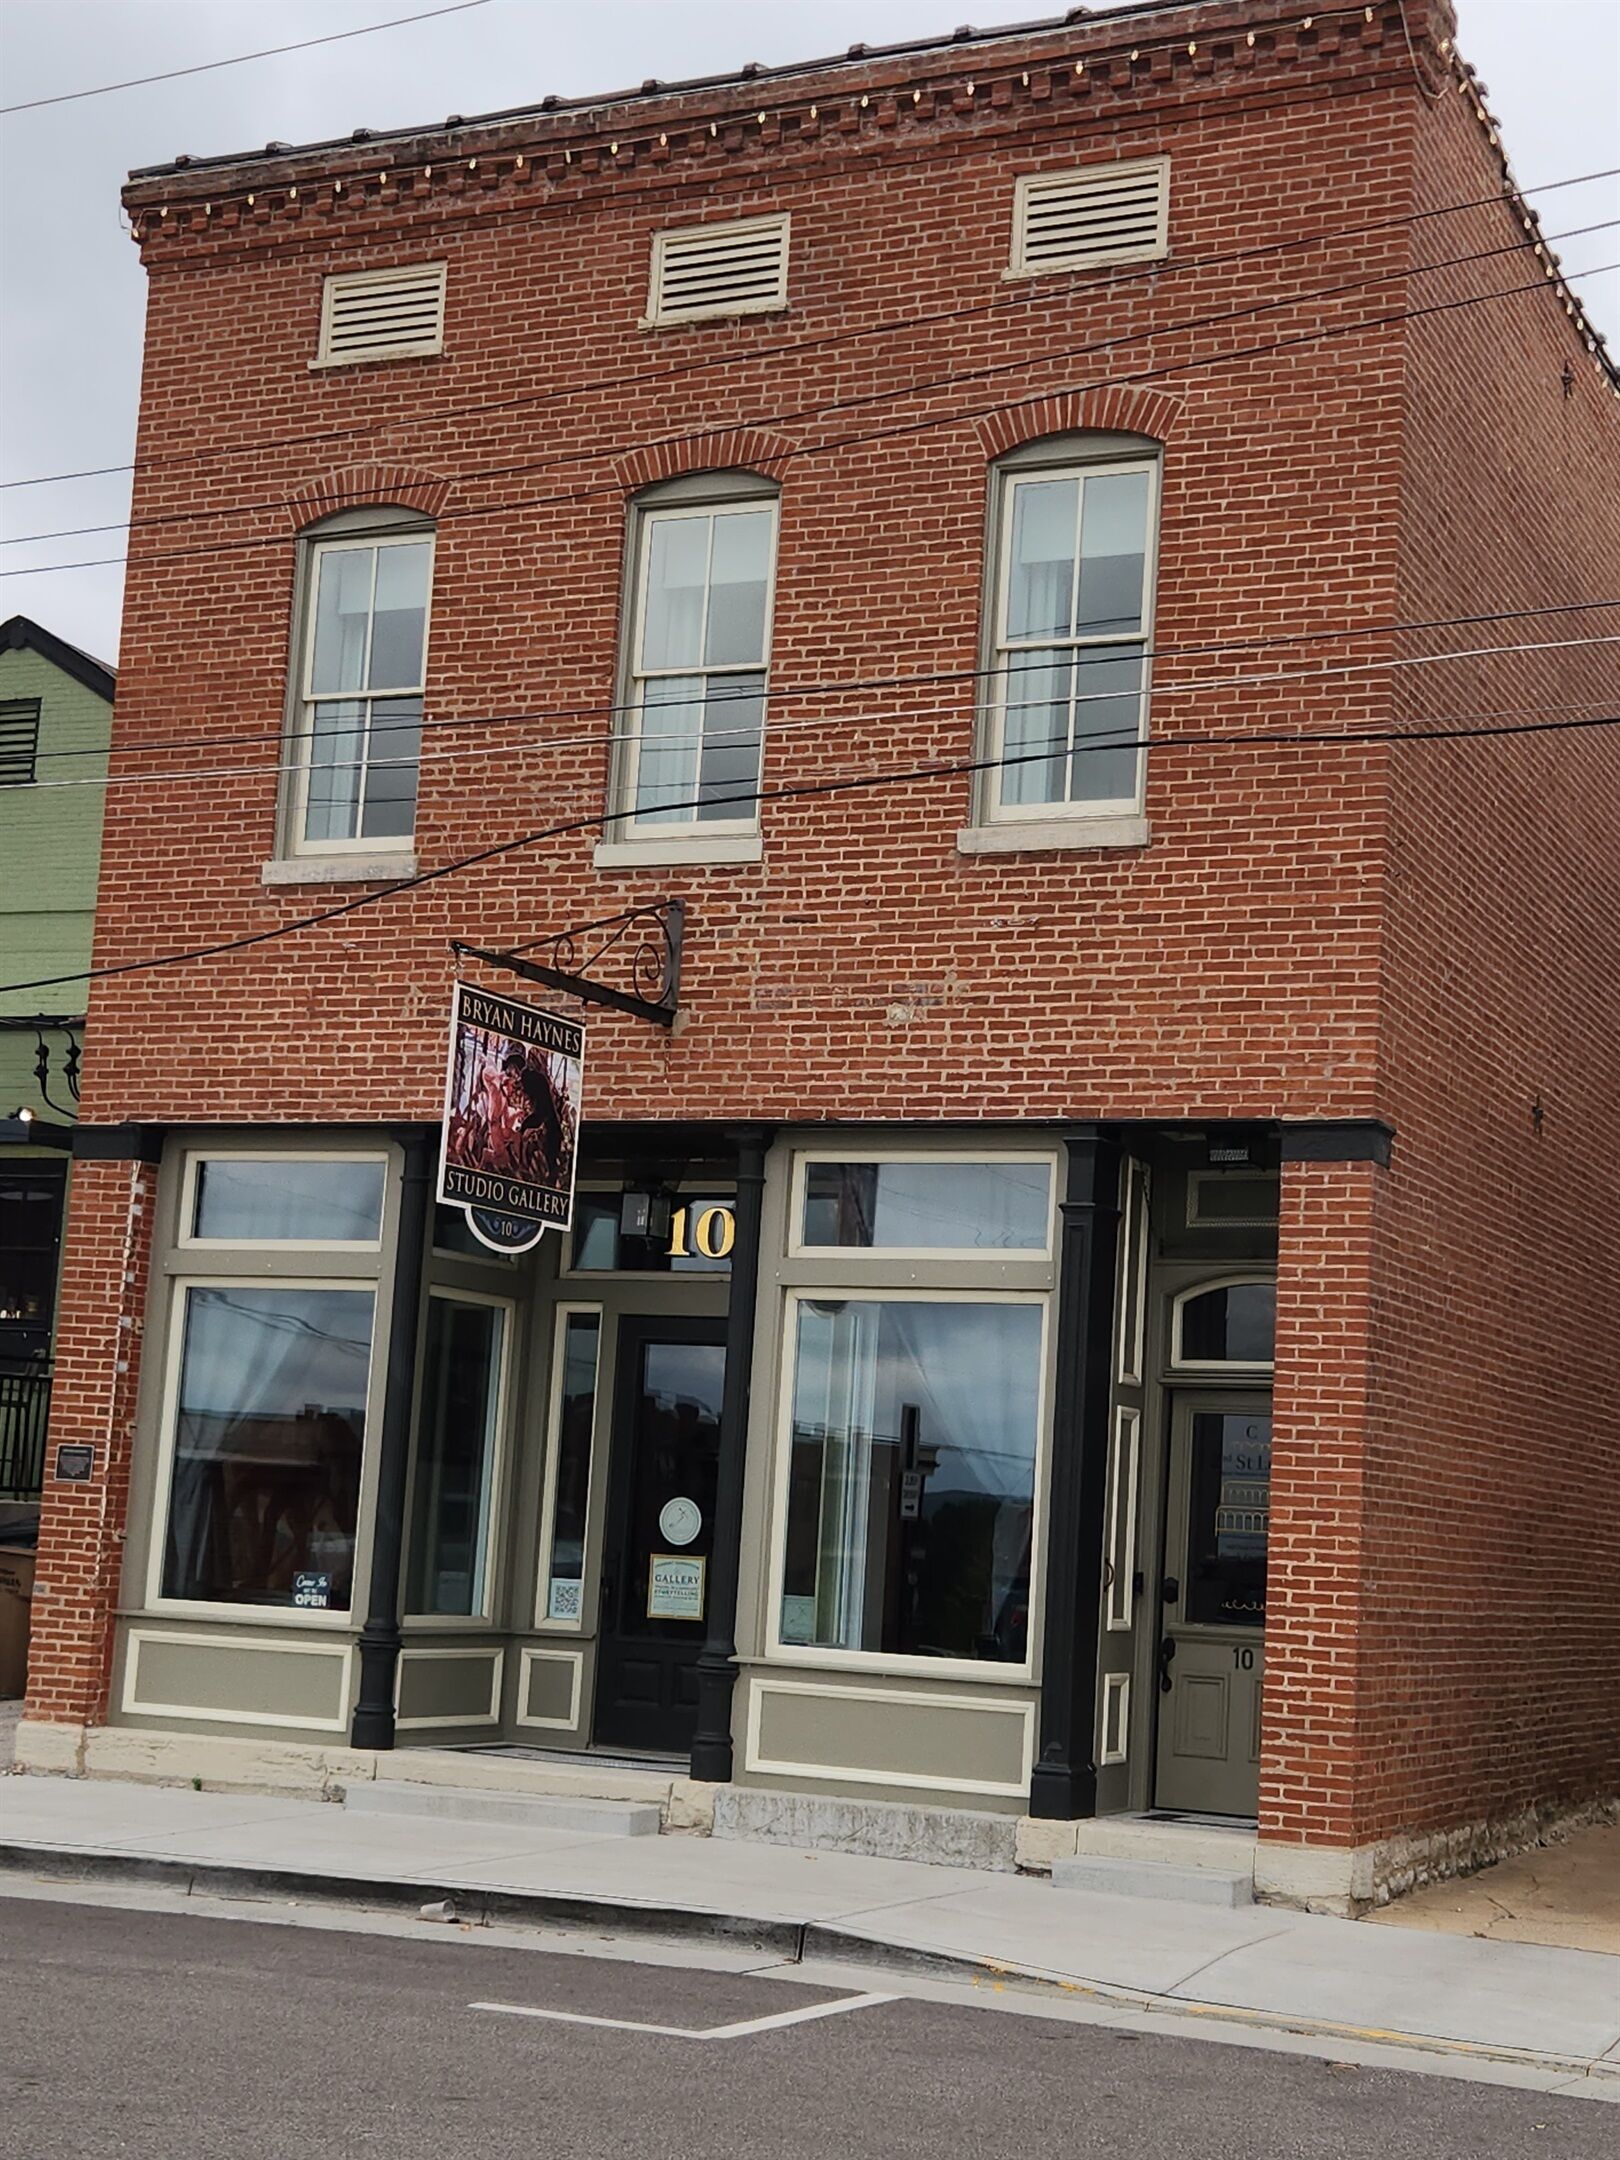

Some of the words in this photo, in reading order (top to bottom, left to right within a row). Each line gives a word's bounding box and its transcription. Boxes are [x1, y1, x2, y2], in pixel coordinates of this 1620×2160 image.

[462, 995, 515, 1031] BRYAN
[520, 1015, 580, 1053] HAYNES
[446, 1170, 504, 1201] STUDIO
[508, 1185, 569, 1217] GALLERY
[501, 1221, 513, 1237] 10
[664, 1206, 736, 1258] 10
[1236, 1454, 1251, 1471] St
[655, 1574, 699, 1584] GALLERY
[295, 1593, 327, 1607] OPEN
[1233, 1647, 1254, 1670] 10
